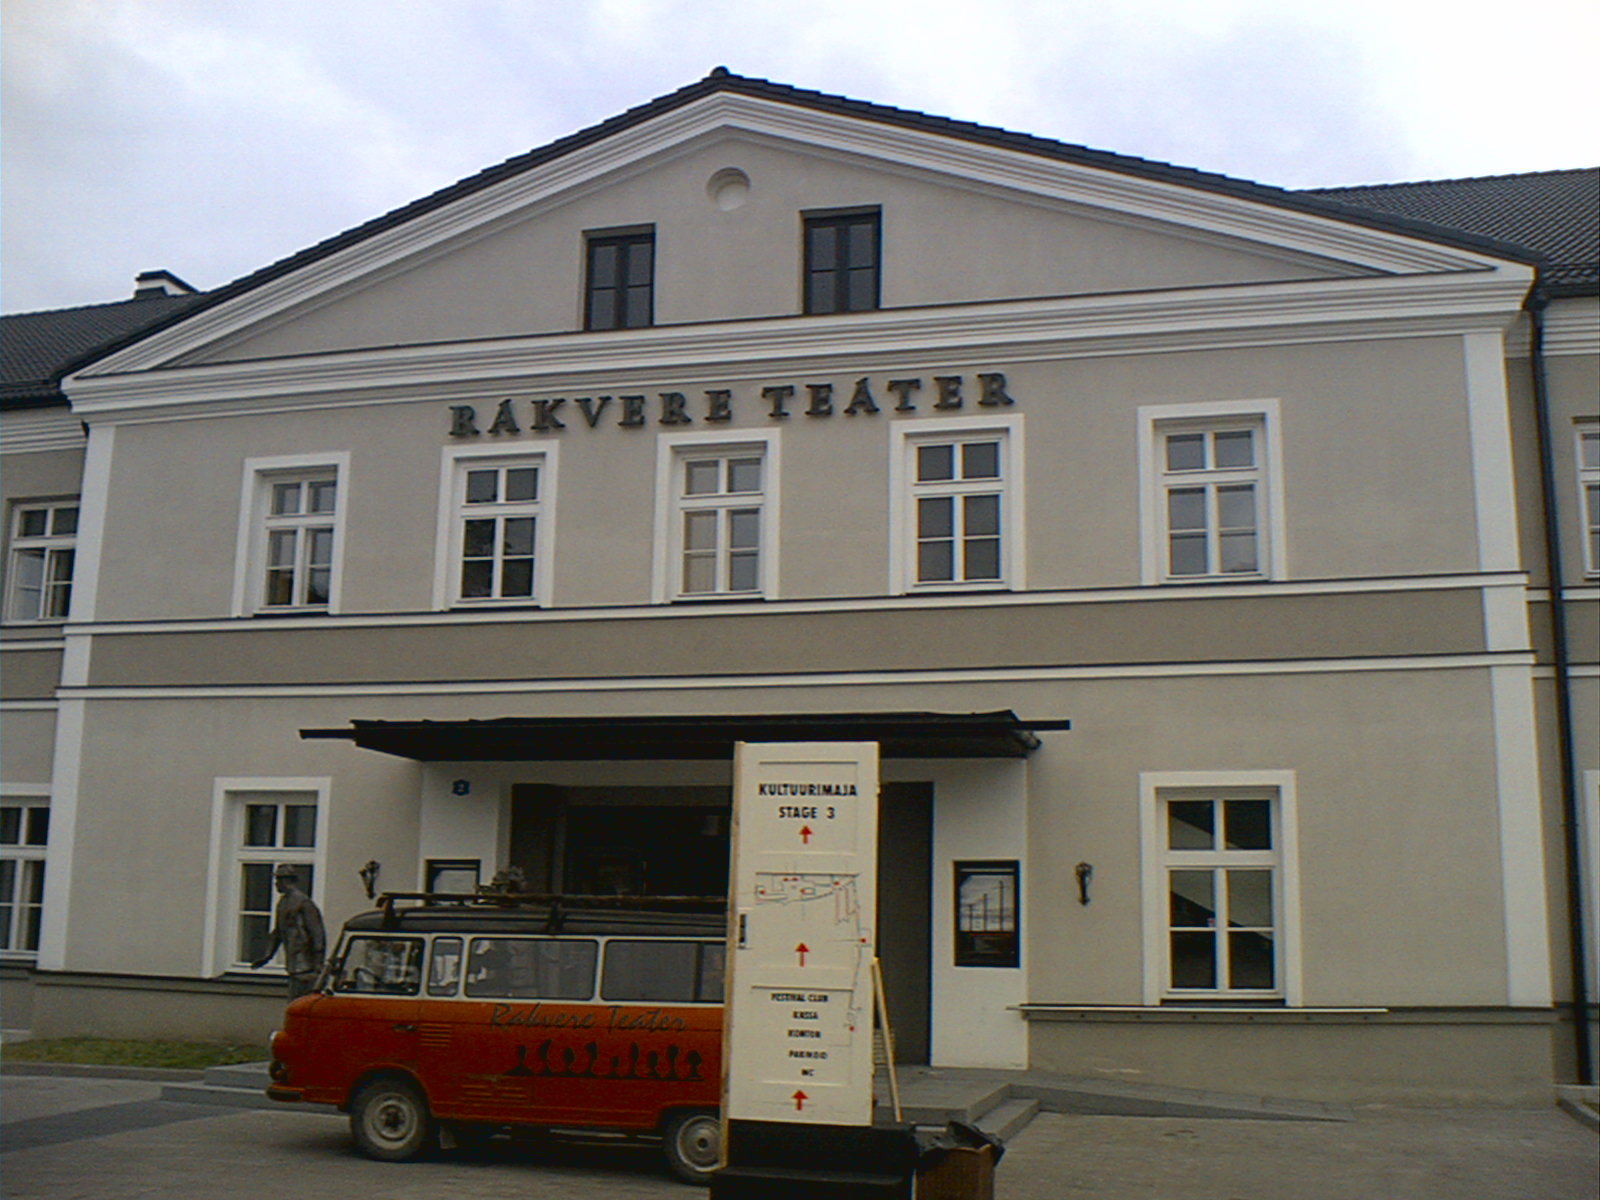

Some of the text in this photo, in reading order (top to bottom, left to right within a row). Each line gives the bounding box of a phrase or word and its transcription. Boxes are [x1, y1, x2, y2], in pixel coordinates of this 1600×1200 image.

[448, 372, 1015, 437] RAKVERE TEATER
[758, 783, 858, 797] KULTUURIMAJA
[779, 806, 835, 819] STAGE 3
[492, 1002, 687, 1032] Rakvere Teater
